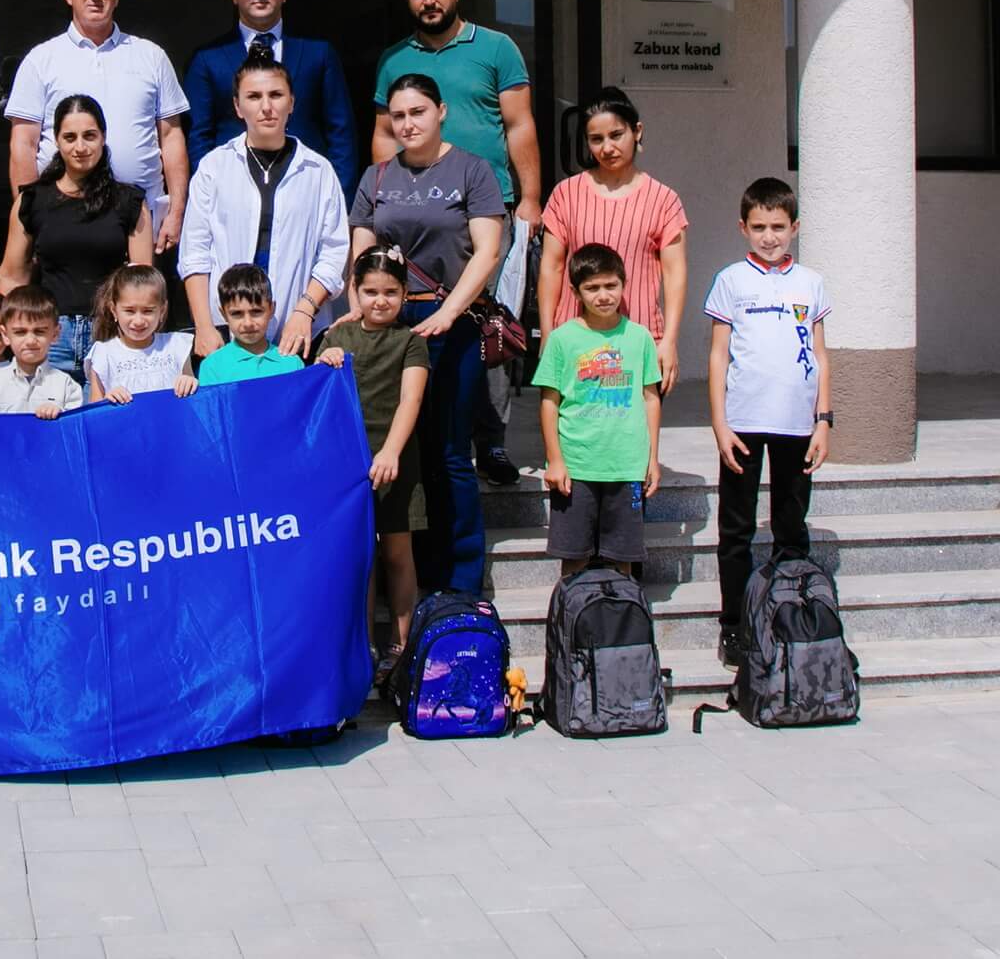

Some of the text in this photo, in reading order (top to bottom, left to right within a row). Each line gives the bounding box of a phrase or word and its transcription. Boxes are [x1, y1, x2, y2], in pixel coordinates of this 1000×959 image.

[633, 41, 721, 56] Zabux kənd
[641, 62, 659, 71] tam
[660, 63, 679, 71] orta
[51, 512, 300, 575] Respublika
[14, 582, 150, 615] faydalı
